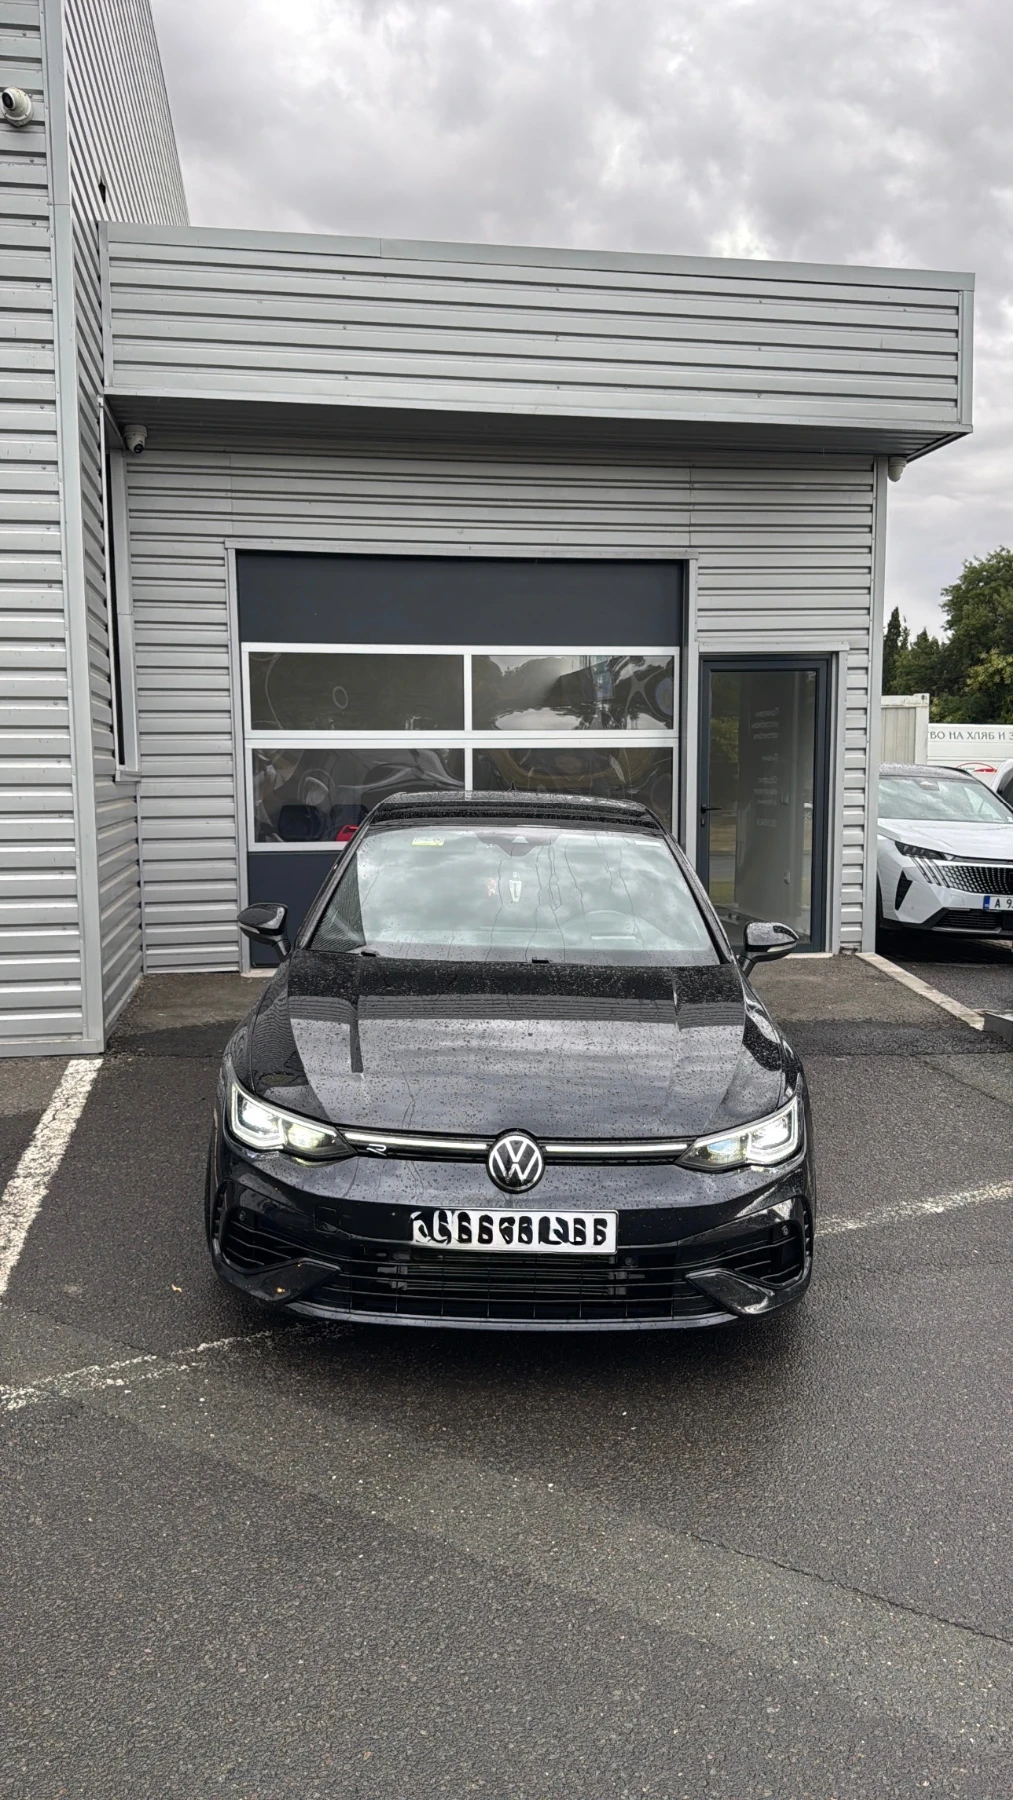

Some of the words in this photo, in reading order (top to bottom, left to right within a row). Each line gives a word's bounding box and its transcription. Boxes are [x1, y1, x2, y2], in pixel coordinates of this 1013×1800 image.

[928, 731, 946, 740] ВО
[949, 731, 964, 740] НА
[967, 731, 995, 740] ХЛЯБ
[998, 731, 1006, 740] И
[994, 898, 1001, 908] A
[1006, 898, 1013, 909] 9
